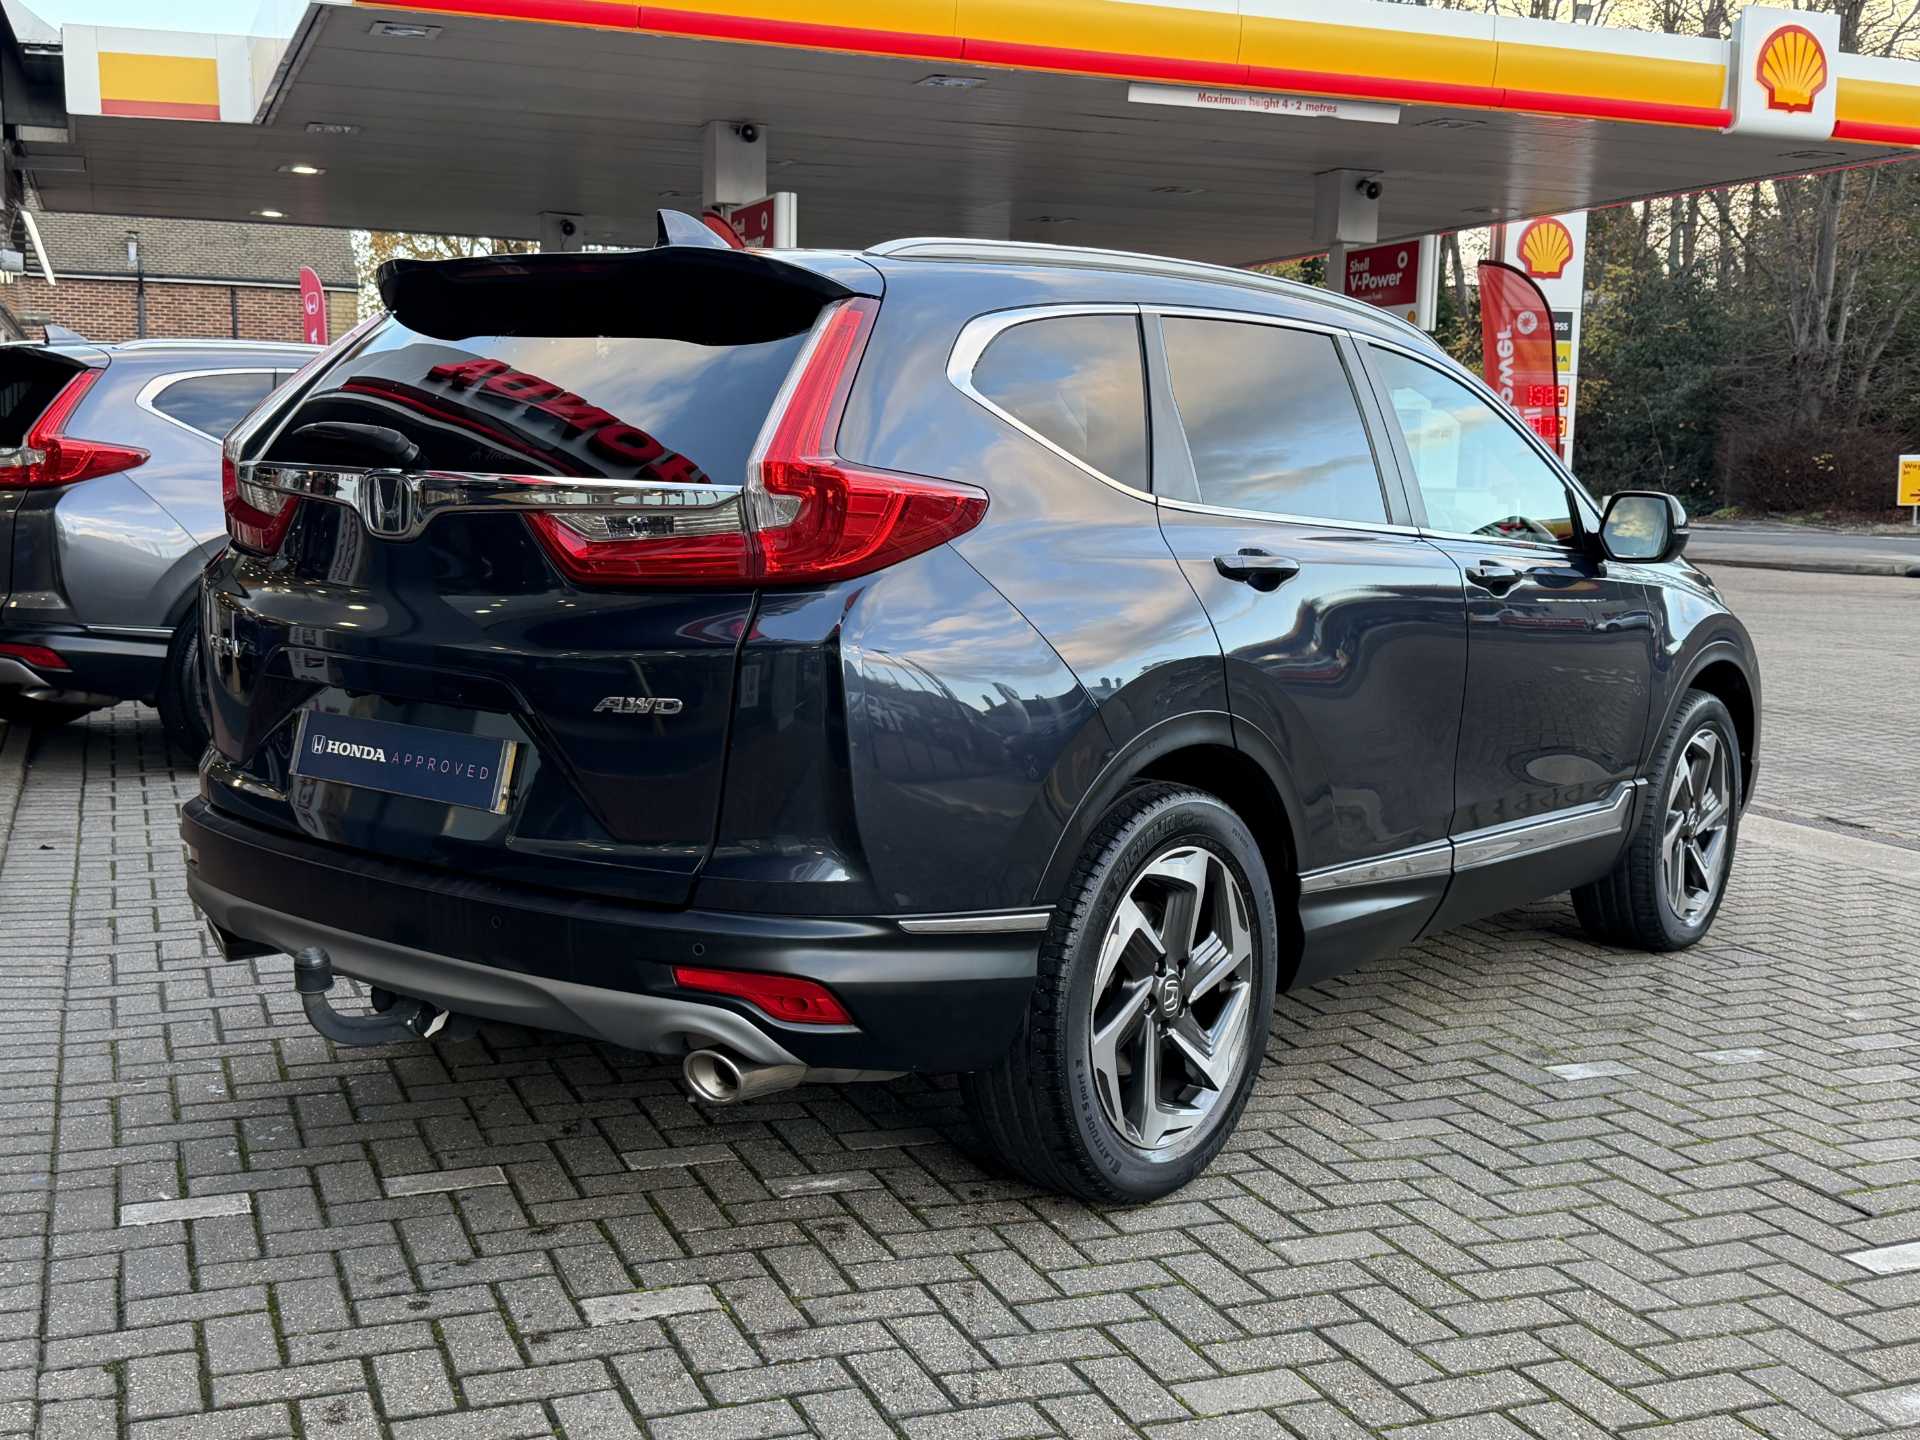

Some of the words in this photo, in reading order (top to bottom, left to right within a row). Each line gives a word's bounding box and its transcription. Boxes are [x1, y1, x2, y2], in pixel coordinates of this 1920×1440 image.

[1196, 91, 1246, 107] Maximum
[1249, 95, 1280, 111] height
[1305, 102, 1337, 114] metres
[1350, 257, 1369, 272] Shell
[1350, 272, 1402, 291] V-Power
[592, 696, 684, 715] AWD
[326, 739, 387, 763] HONDA
[392, 751, 490, 781] APPROVED
[1077, 1073, 1091, 1112] Sport
[1085, 1113, 1116, 1167] LATITUDE
